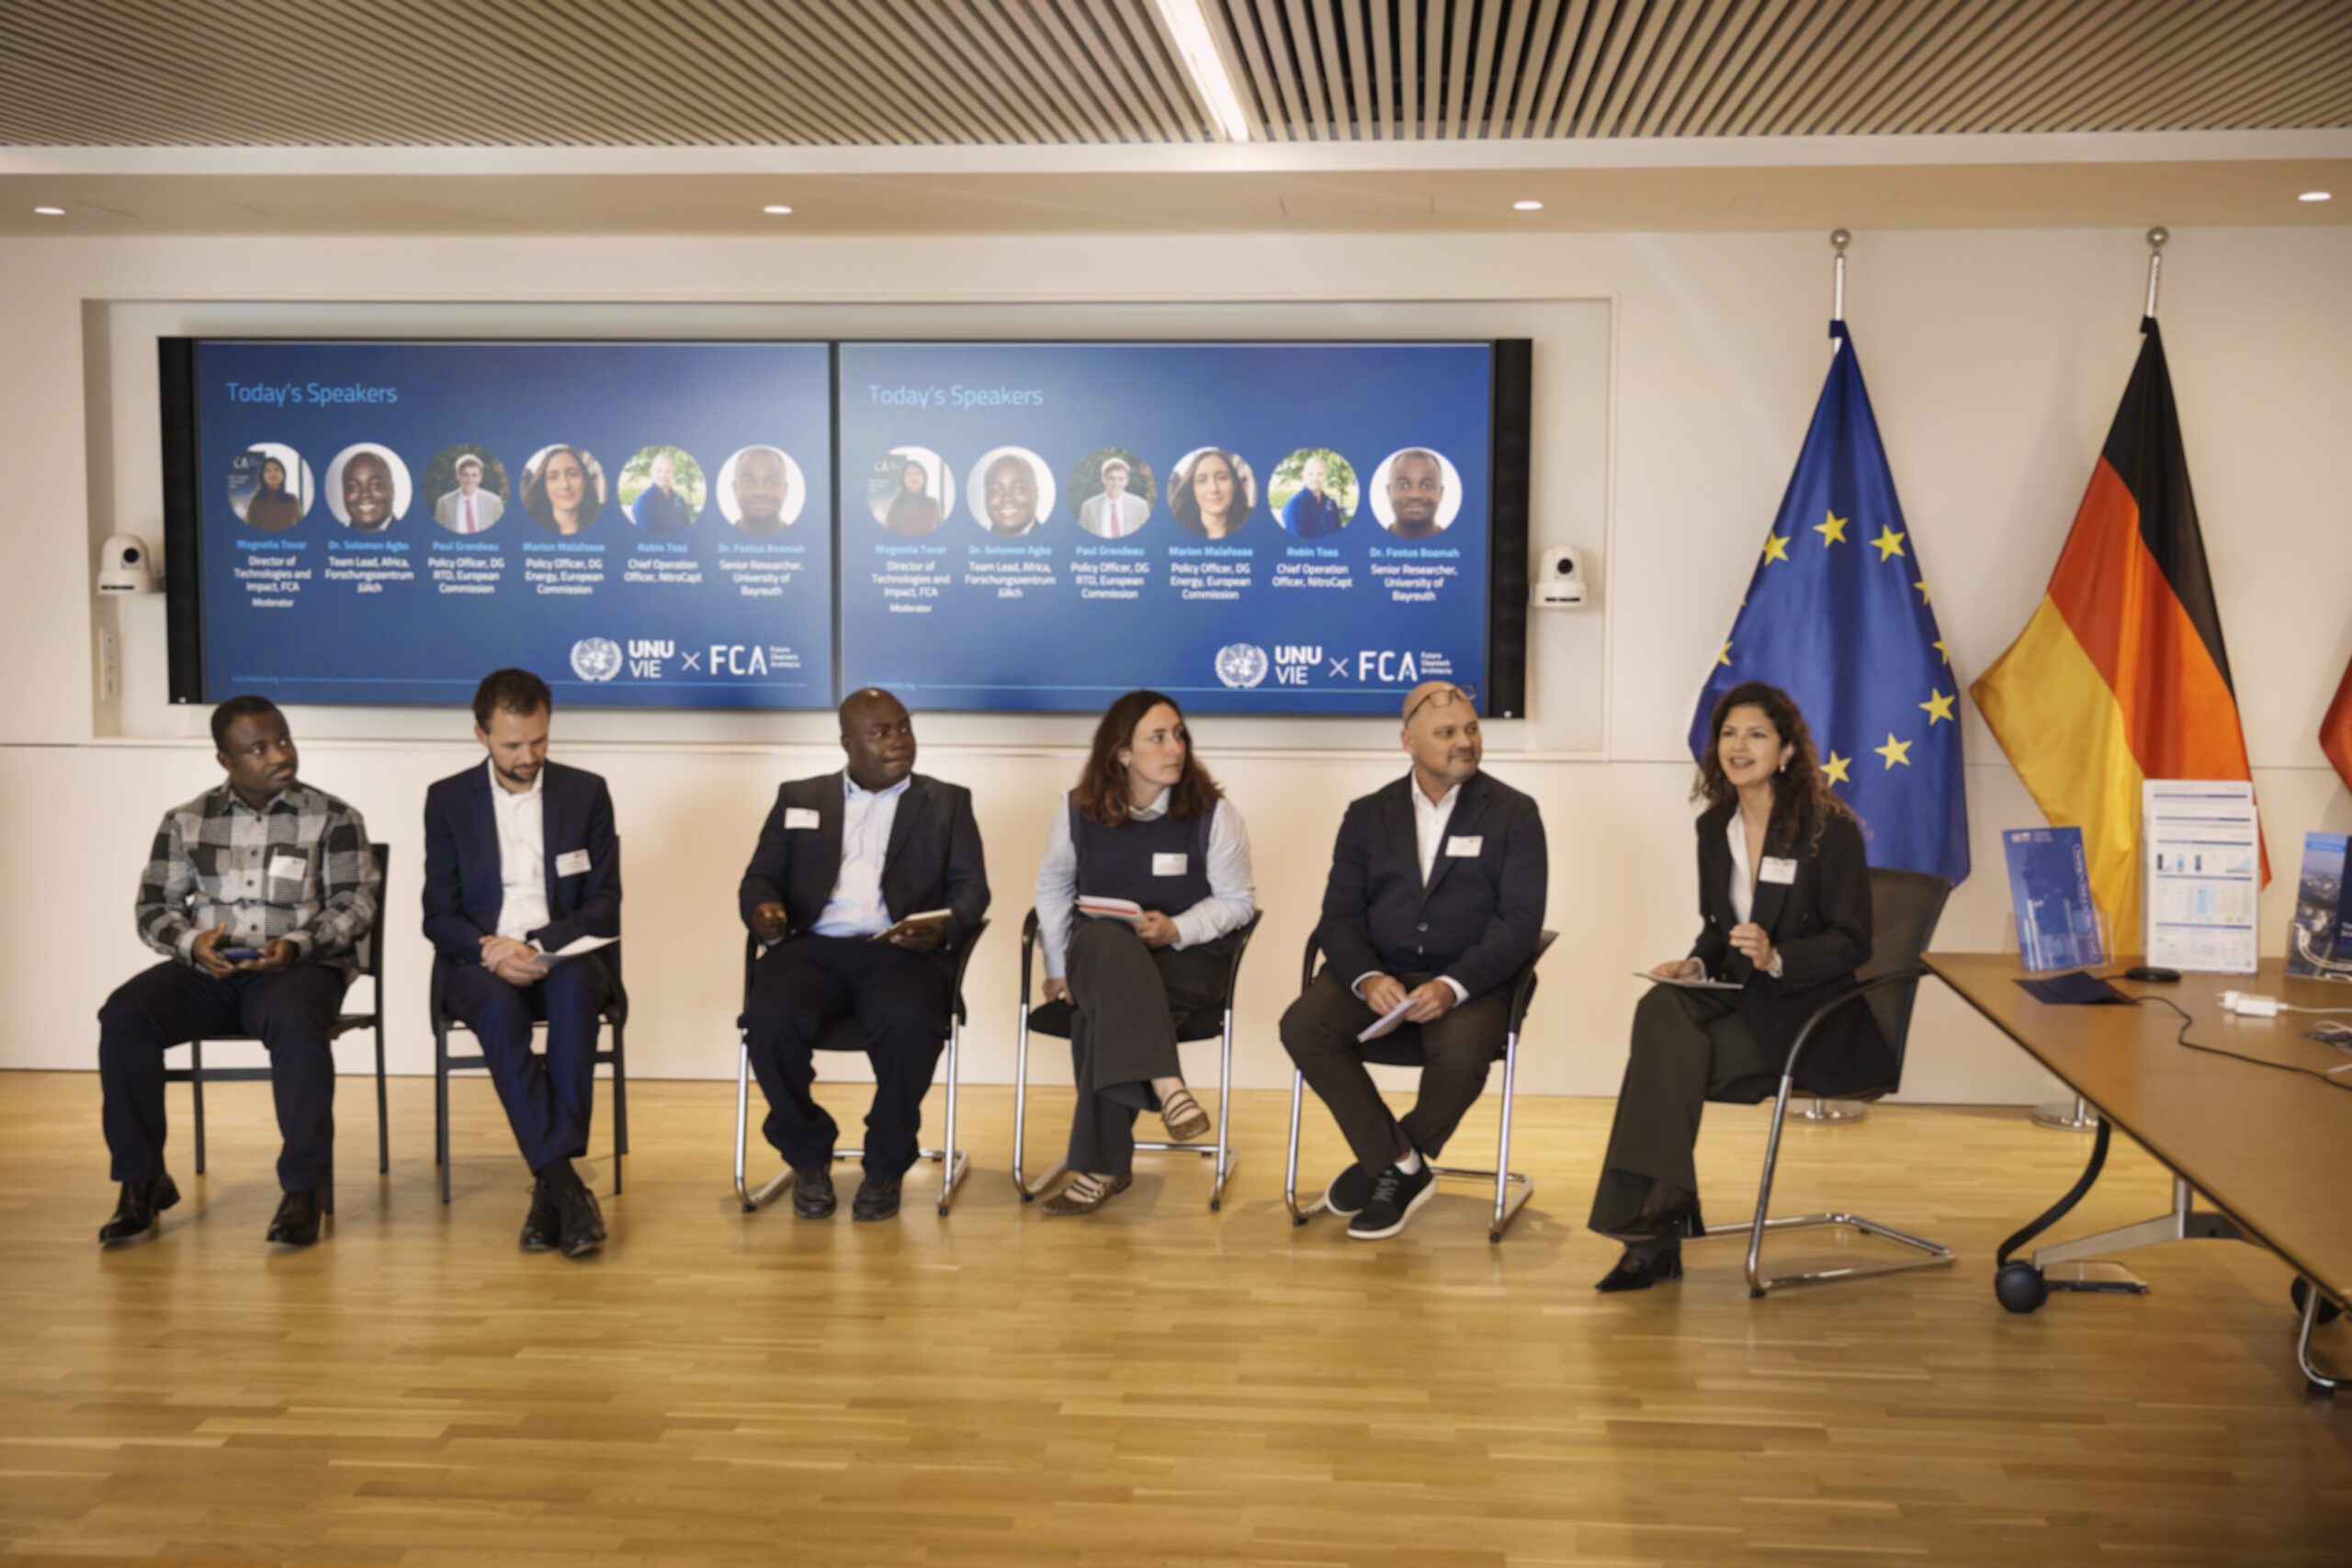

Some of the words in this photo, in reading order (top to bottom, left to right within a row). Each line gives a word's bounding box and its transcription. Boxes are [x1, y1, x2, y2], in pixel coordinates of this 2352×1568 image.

[226, 382, 302, 407] Today's
[306, 382, 399, 407] Speakers
[868, 384, 945, 409] Today's
[950, 384, 1044, 409] Speakers
[432, 541, 453, 552] Paul
[1076, 545, 1097, 557] Paul
[248, 556, 282, 568] Director
[283, 556, 296, 568] of
[328, 557, 353, 568] Team
[356, 557, 378, 569] Lead,
[380, 557, 409, 569] Africa,
[428, 557, 454, 570] Policy
[457, 557, 489, 569] Officer,
[491, 558, 504, 569] DG
[526, 558, 552, 570] Policy
[554, 558, 586, 570] Officer,
[588, 558, 603, 570] DG
[628, 558, 650, 570] Chief
[652, 558, 697, 571] Operation
[719, 559, 748, 570] Senior
[750, 559, 803, 571] Researcher,
[887, 560, 921, 571] Director
[922, 560, 935, 571] of
[969, 561, 994, 572] Team
[996, 561, 1019, 573] Lead,
[1022, 561, 1052, 574] Africa,
[1070, 562, 1097, 575] Policy
[1100, 562, 1133, 574] Officer,
[1135, 563, 1149, 574] DG
[1171, 562, 1199, 575] Policy
[1201, 562, 1234, 574] Officer,
[1236, 563, 1250, 574] DG
[234, 569, 294, 581] Technologies
[297, 569, 311, 580] and
[324, 569, 413, 582] Forschungszentrum
[1276, 563, 1300, 574] Chief
[1302, 563, 1349, 576] Operation
[1371, 564, 1399, 575] Senior
[1402, 564, 1457, 577] Researcher,
[457, 570, 500, 583] European
[526, 571, 559, 584] Energy,
[561, 571, 604, 583] European
[624, 571, 657, 583] Officer,
[733, 572, 778, 585] University
[779, 572, 790, 583] of
[872, 573, 933, 586] Technologies
[936, 573, 950, 584] and
[965, 574, 1056, 587] Forschungszentrum
[1100, 576, 1144, 589] European
[1170, 576, 1204, 589] Energy,
[1206, 576, 1250, 589] European
[1272, 576, 1306, 588] Officer,
[1307, 576, 1352, 589] NitroCapt
[246, 581, 279, 594] Impact,
[281, 581, 300, 592] FCA
[356, 581, 382, 593] Jülich
[439, 583, 494, 594] Commission
[537, 583, 593, 595] Commission
[1385, 577, 1430, 590] University
[1432, 577, 1444, 588] of
[741, 585, 783, 597] Bayreuth
[884, 586, 918, 599] Impact,
[920, 586, 938, 597] FCA
[997, 587, 1023, 598] Jülich
[1081, 589, 1138, 599] Commission
[1182, 589, 1239, 600] Commission
[1392, 590, 1435, 603] Bayreuth
[252, 598, 294, 608] Moderator
[889, 603, 933, 613] Moderator
[628, 640, 675, 659] UNU
[710, 646, 767, 675] FCA
[1274, 646, 1322, 664] UNU
[1359, 651, 1418, 682] FCA
[629, 660, 662, 678] VIE
[1275, 666, 1308, 684] VIE
